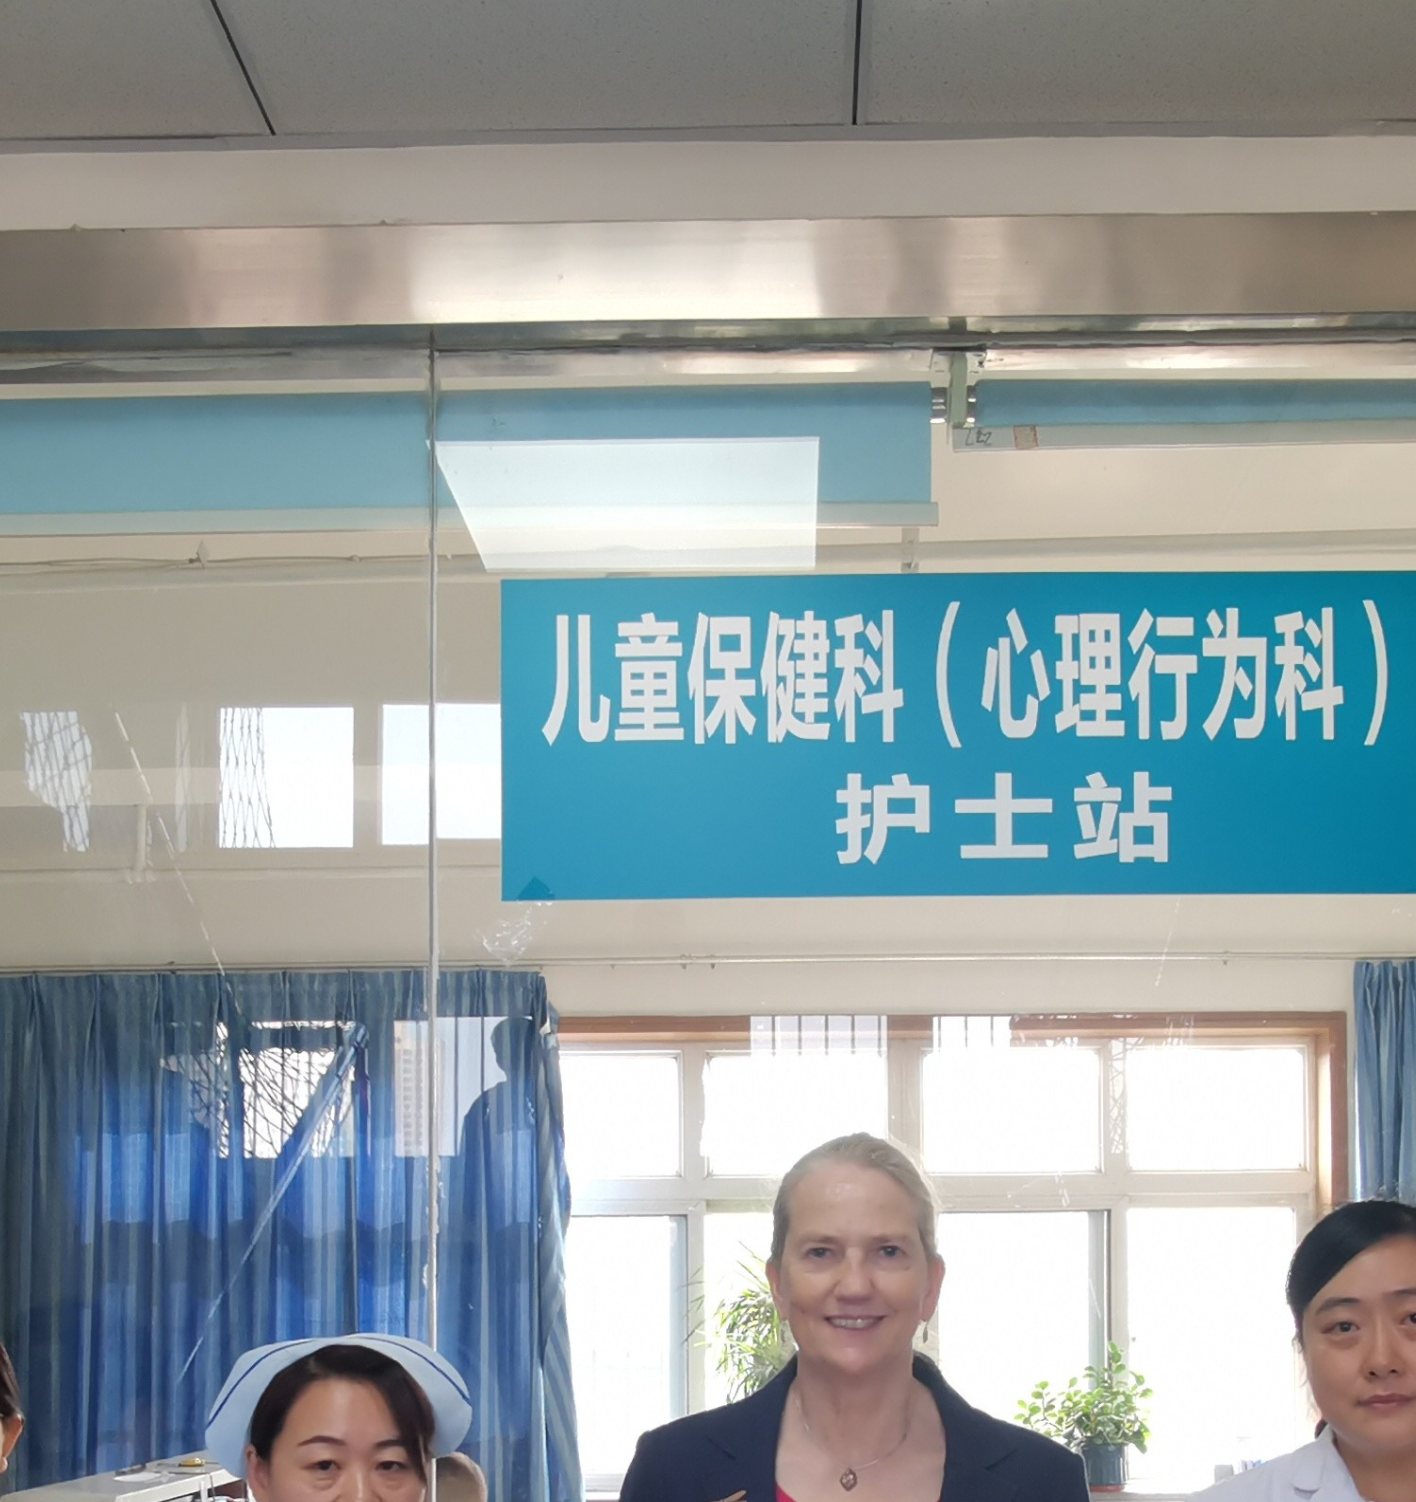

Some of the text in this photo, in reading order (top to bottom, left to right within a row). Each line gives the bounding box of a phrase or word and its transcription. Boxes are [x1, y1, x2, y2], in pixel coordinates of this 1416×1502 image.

[542, 600, 1389, 748] 儿童保健科（心理行为科）
[834, 771, 1173, 865] 护士站
